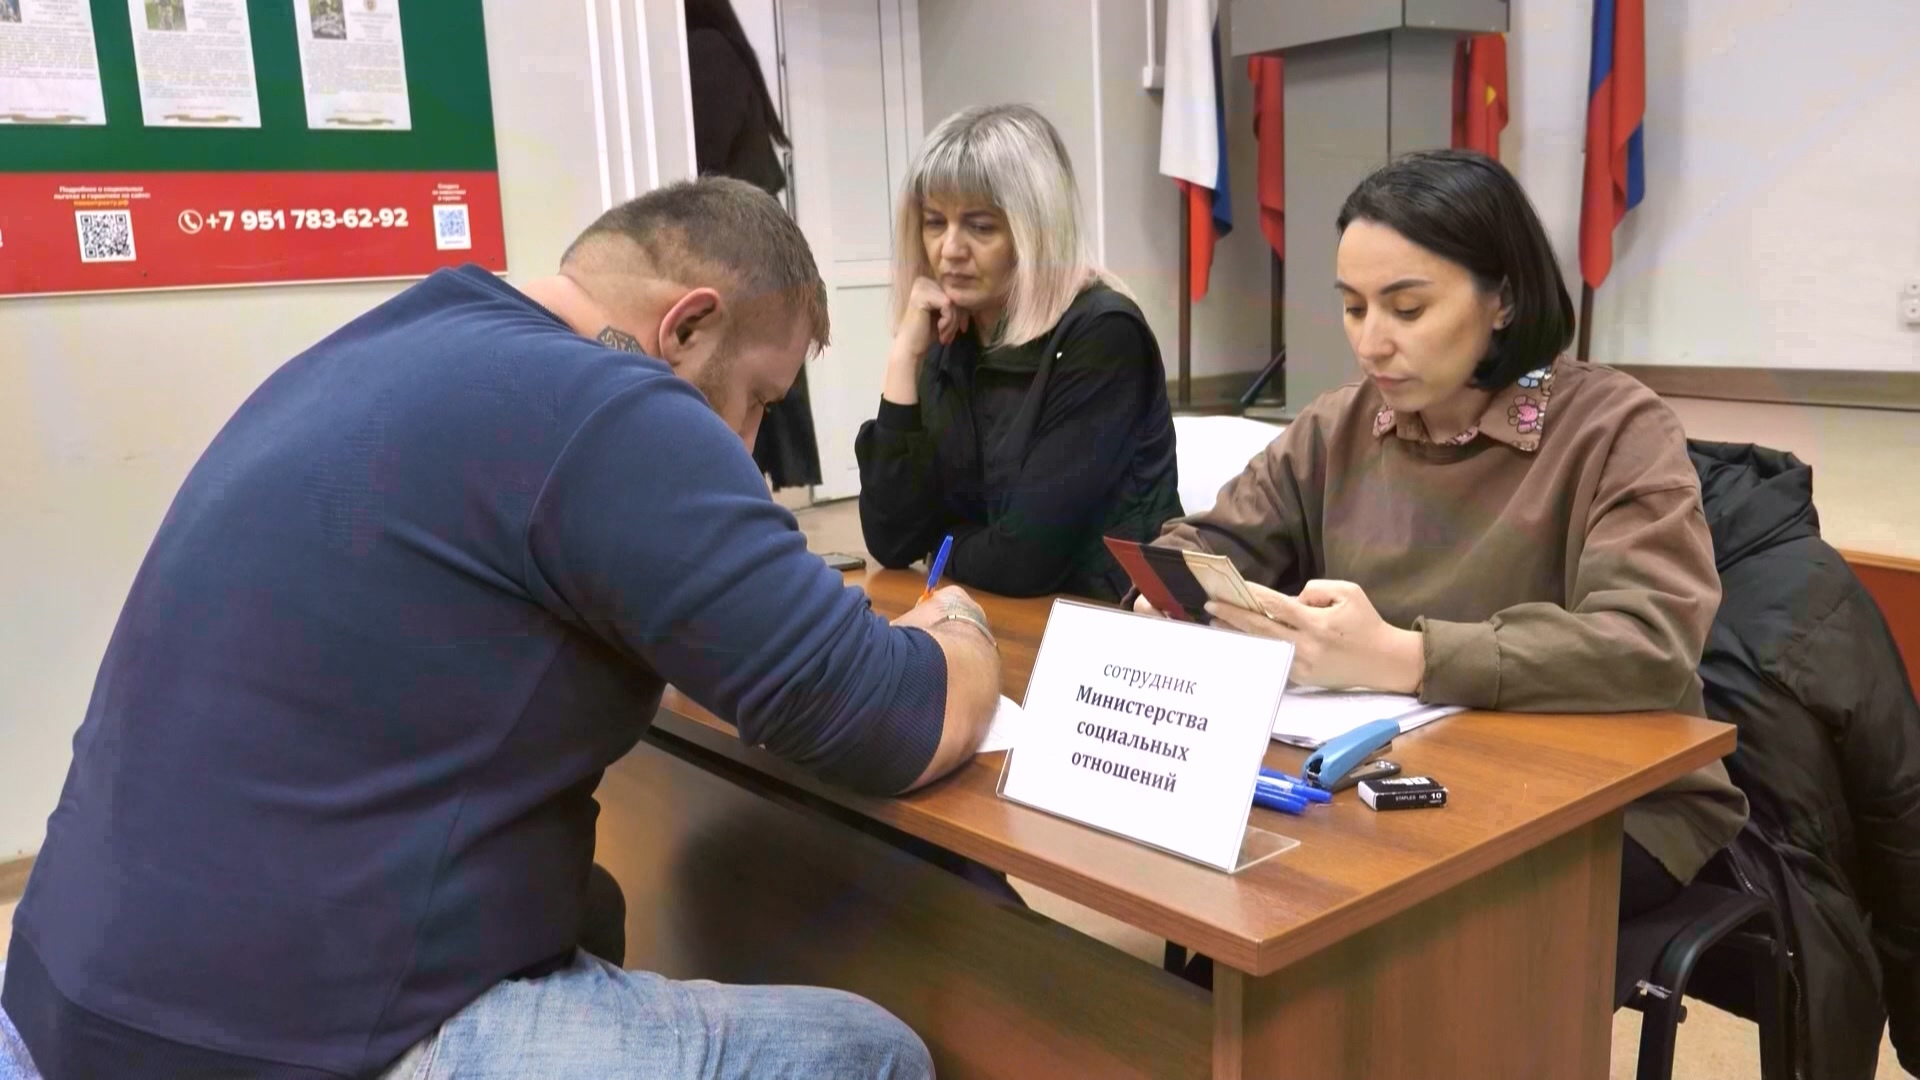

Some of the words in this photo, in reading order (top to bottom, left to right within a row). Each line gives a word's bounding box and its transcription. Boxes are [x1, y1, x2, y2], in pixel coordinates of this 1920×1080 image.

[206, 210, 235, 232] +7
[240, 209, 286, 231] 951
[290, 207, 409, 230] 783-62-92
[1103, 662, 1198, 695] сотрудник
[1075, 684, 1209, 732] Министерства
[1076, 720, 1190, 762] социальных
[1071, 751, 1177, 793] отношений
[1395, 794, 1416, 802] STAPLES
